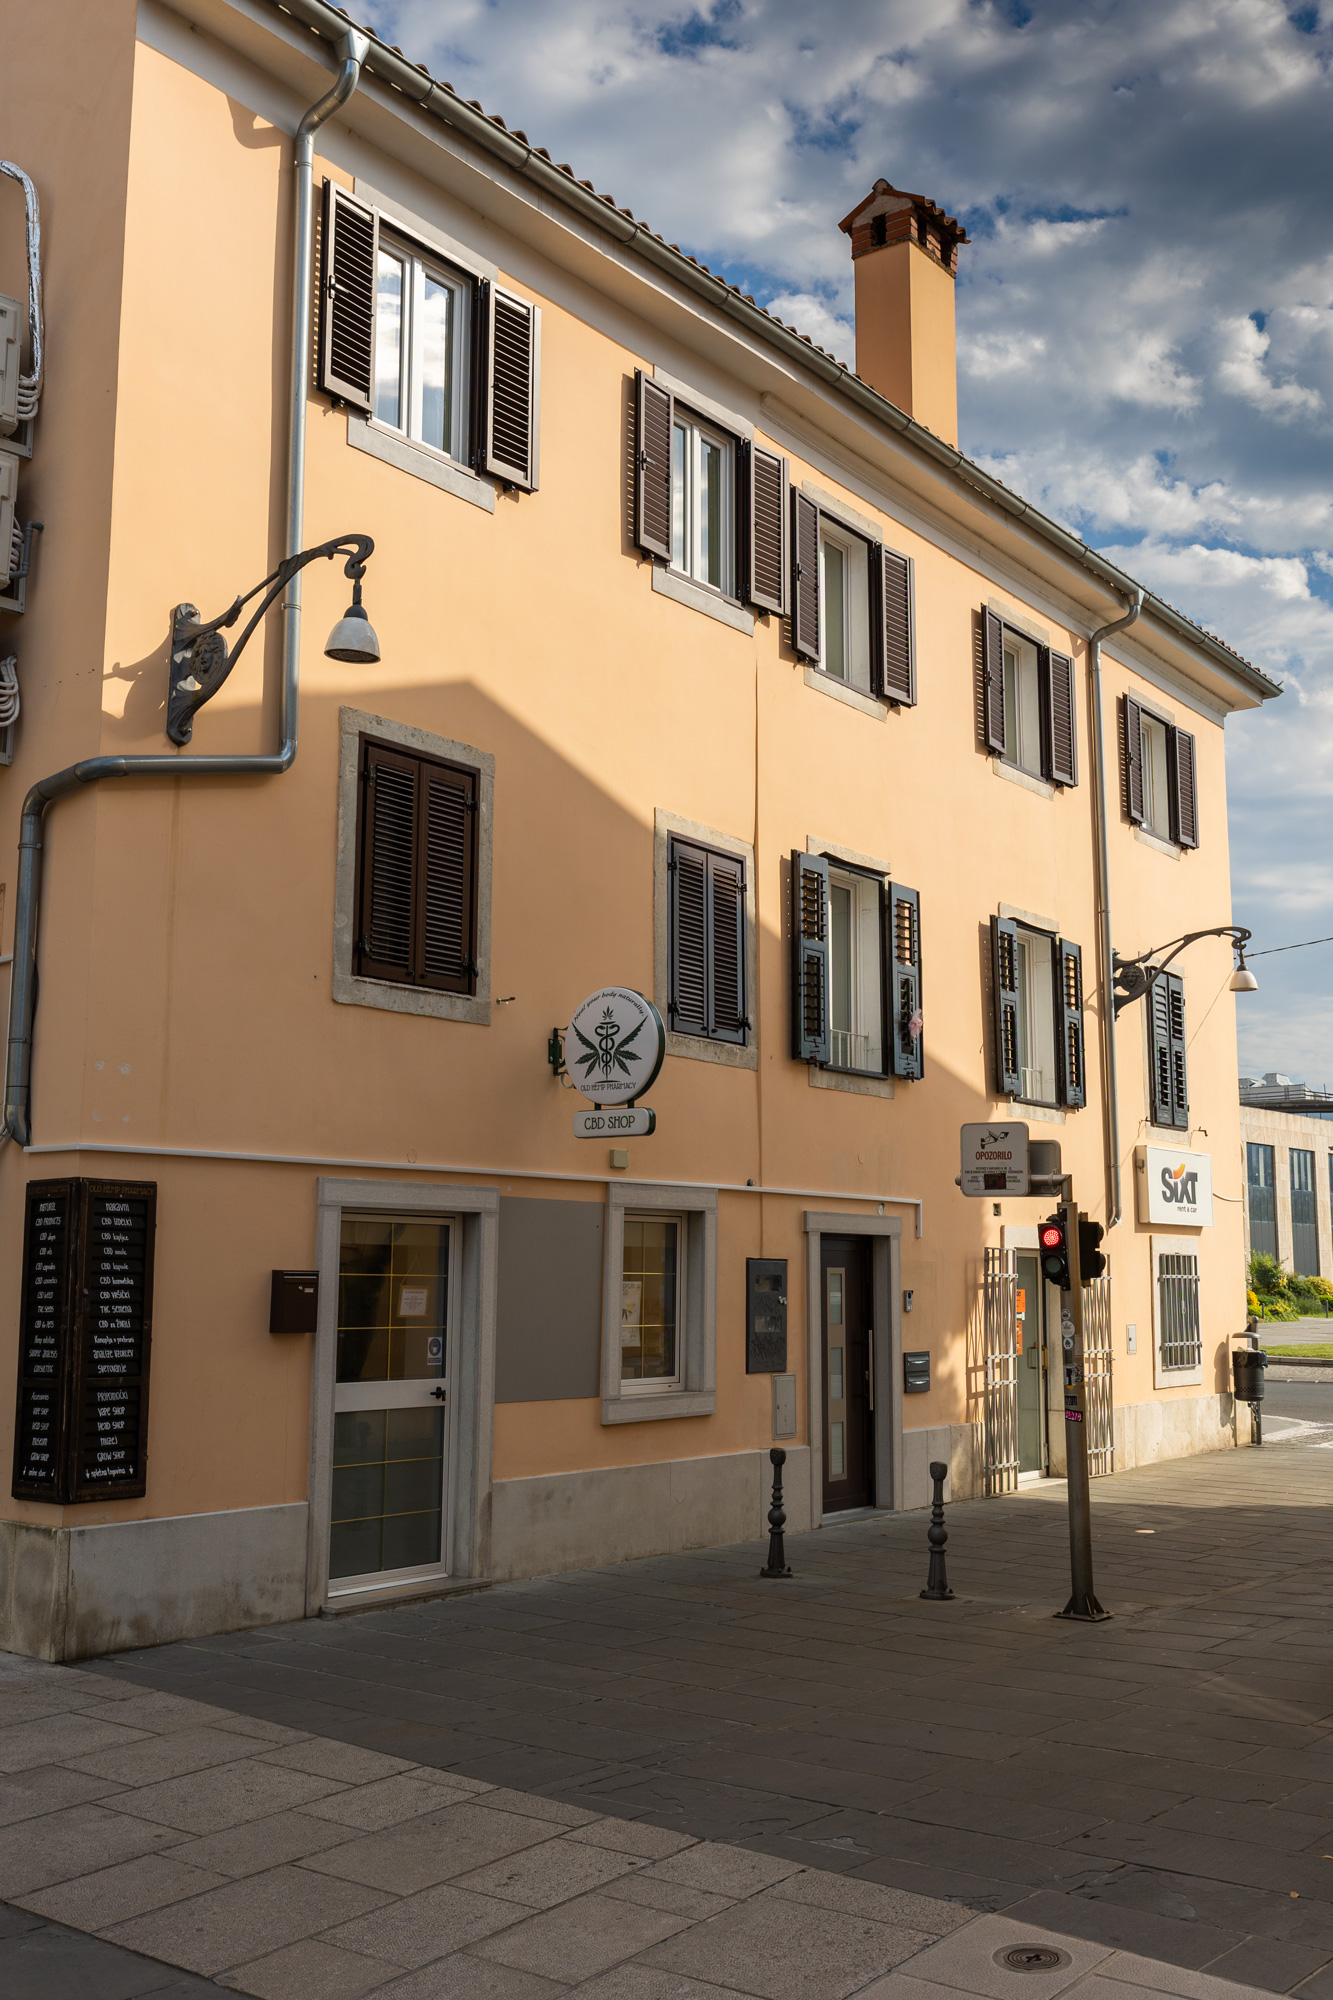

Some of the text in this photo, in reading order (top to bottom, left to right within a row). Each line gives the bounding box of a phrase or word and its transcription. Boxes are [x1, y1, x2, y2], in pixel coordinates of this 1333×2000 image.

[580, 1082, 636, 1092] OLD HEMP PHARMACY
[584, 1116, 636, 1130] CBD SHOP
[975, 1151, 1012, 1160] OPOZORILO
[90, 1185, 155, 1196] OLD HEMP PHARMACY
[100, 1276, 111, 1284] CBD
[99, 1320, 108, 1328] CBD
[112, 1406, 125, 1415] SHOP
[112, 1421, 124, 1429] SHOP
[97, 1451, 125, 1462] GROW SHOP
